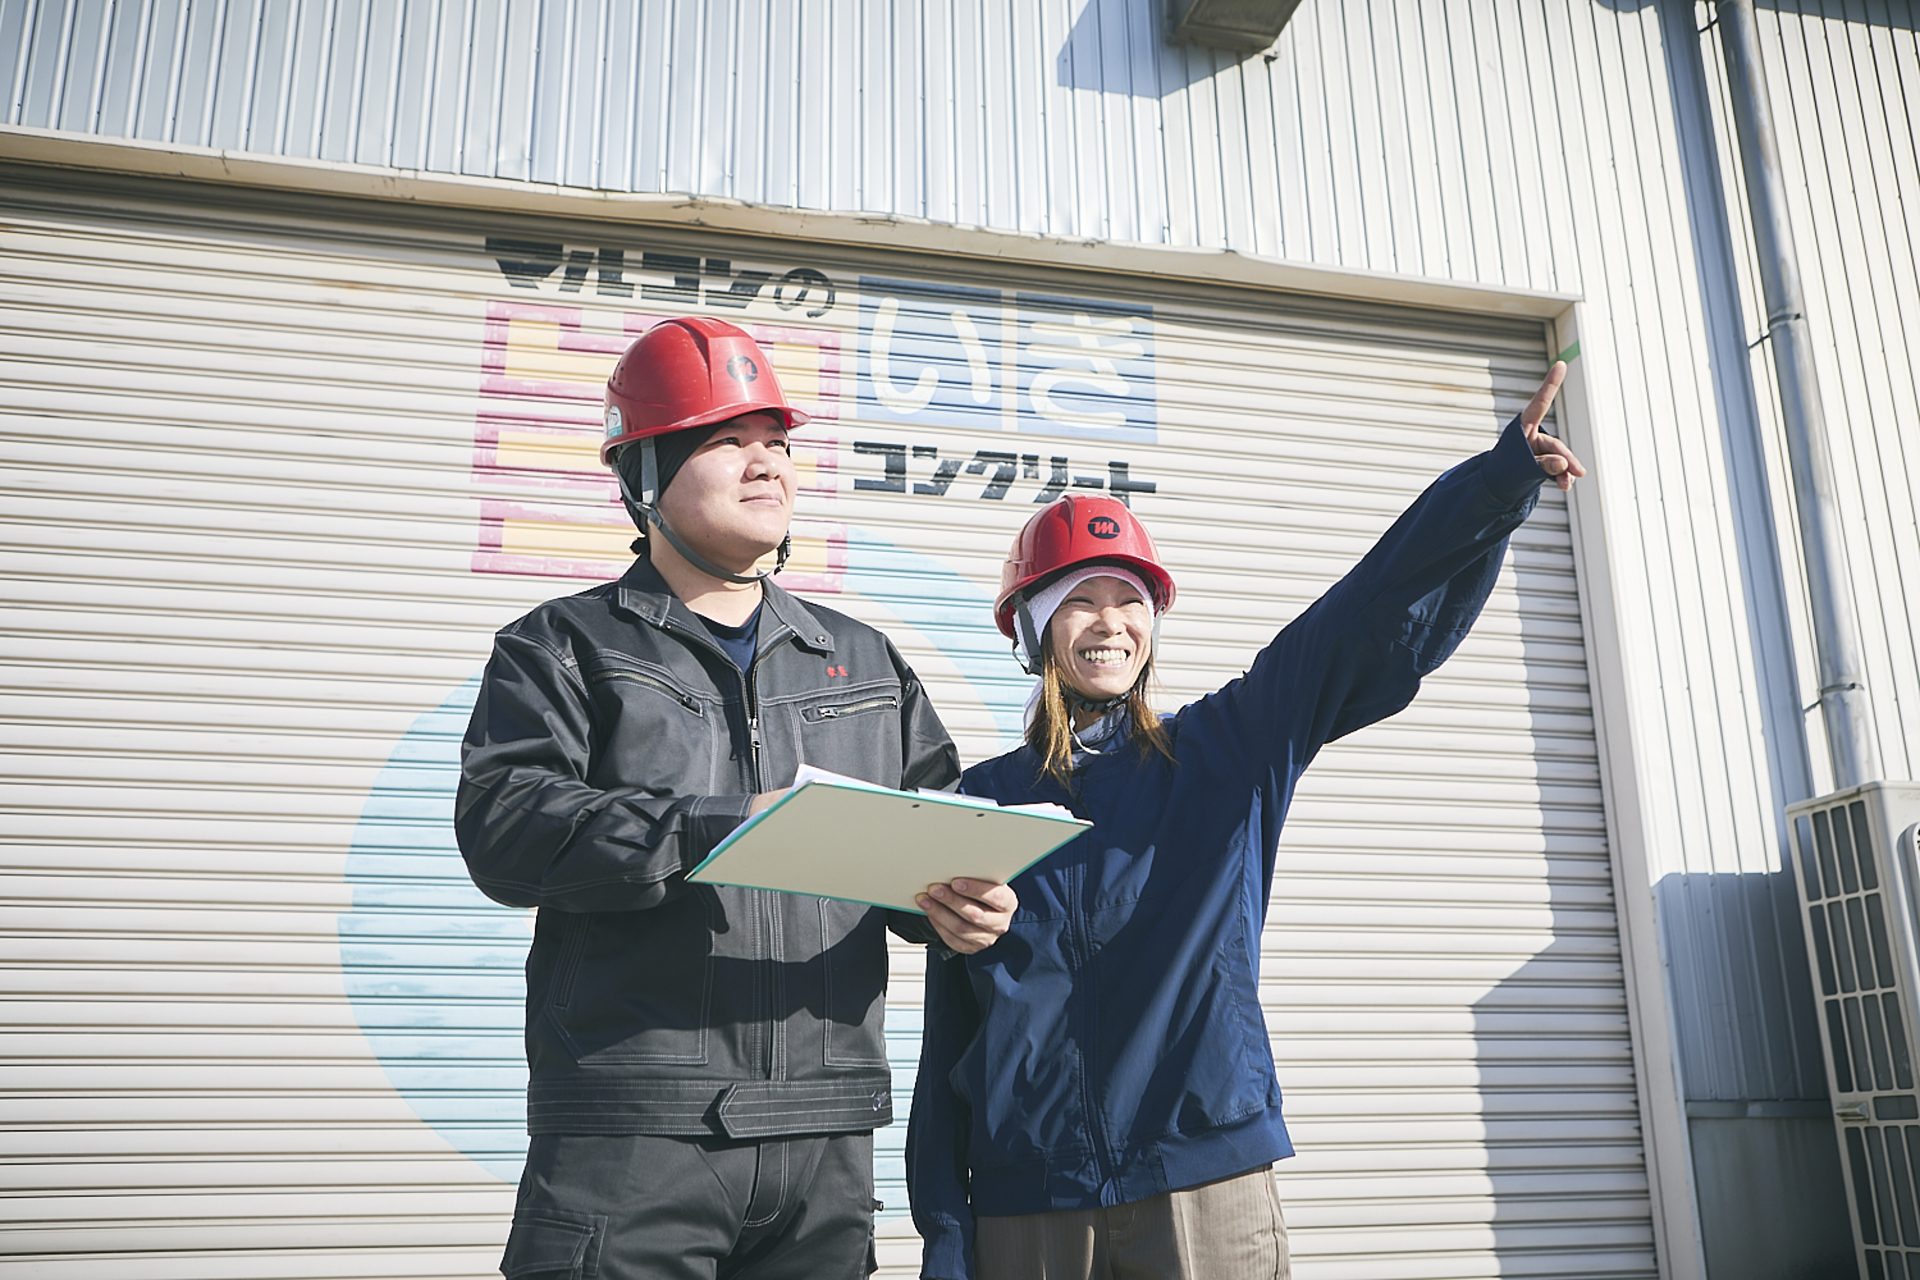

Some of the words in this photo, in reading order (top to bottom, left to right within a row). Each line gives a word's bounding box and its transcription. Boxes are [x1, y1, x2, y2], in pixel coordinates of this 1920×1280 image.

[485, 237, 836, 318] マルコンの
[853, 441, 1157, 508] コンクリート
